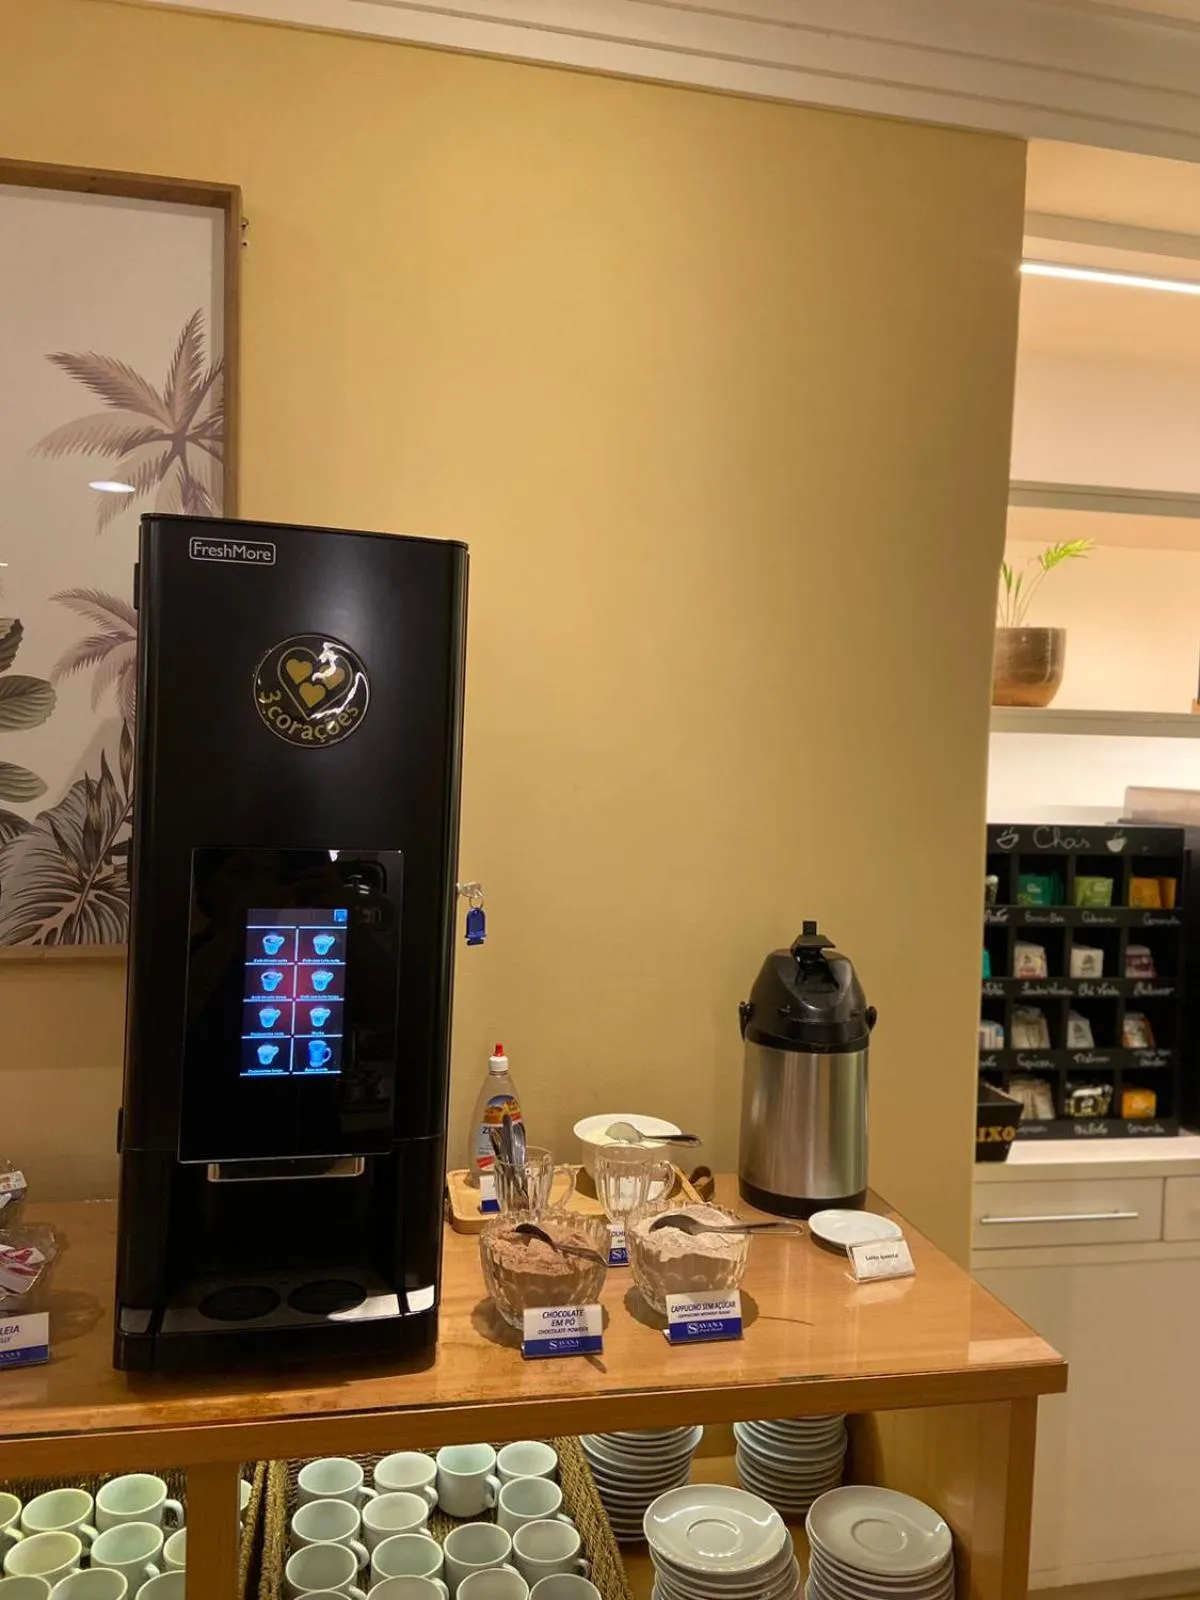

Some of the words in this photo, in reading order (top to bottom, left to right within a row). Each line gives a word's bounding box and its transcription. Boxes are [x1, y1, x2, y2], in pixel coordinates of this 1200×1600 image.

[193, 541, 272, 561] FreshMore
[542, 1309, 585, 1319] CHOCOLATE
[551, 1319, 564, 1327] EM
[565, 1318, 576, 1326] PÓ
